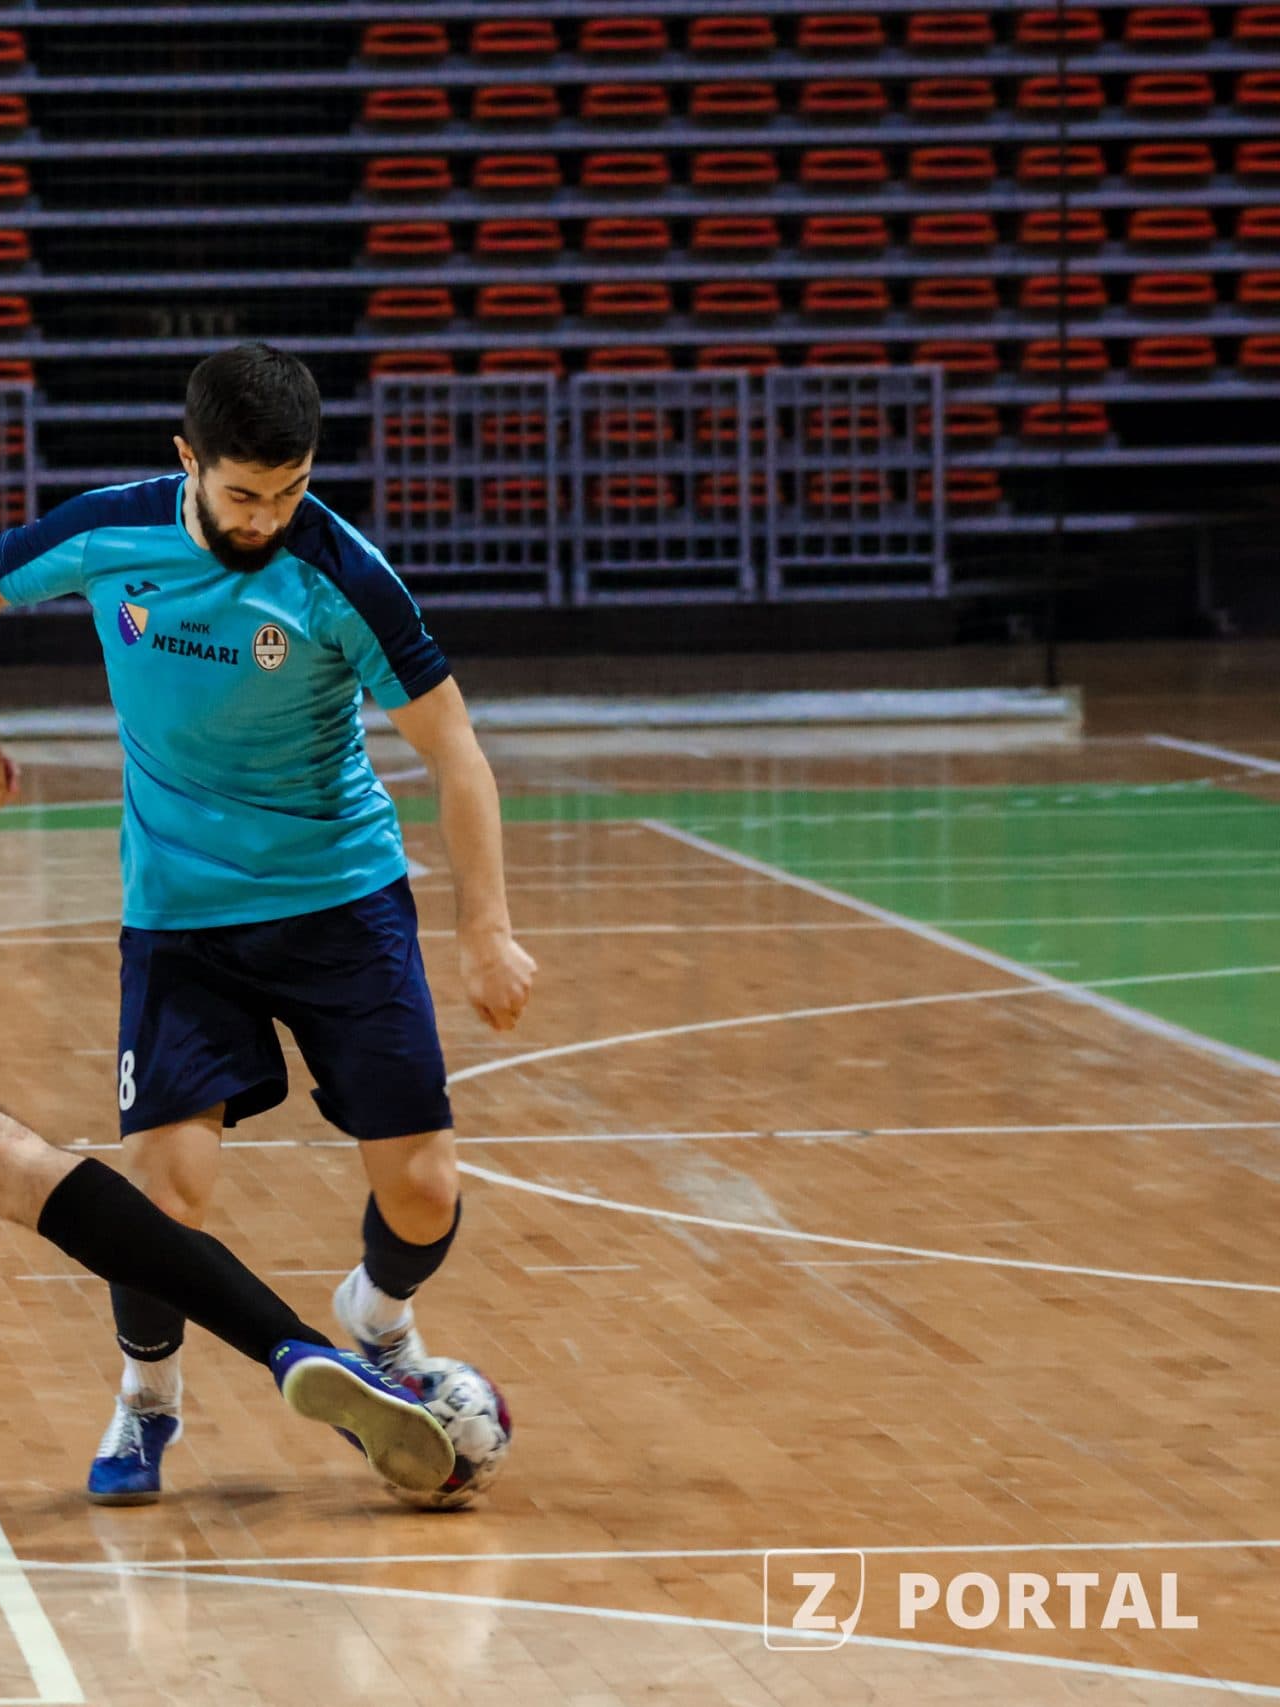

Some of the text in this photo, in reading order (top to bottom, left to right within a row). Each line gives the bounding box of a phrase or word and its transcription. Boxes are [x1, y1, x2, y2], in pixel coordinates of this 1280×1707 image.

[180, 621, 211, 635] MNK
[151, 633, 239, 665] NEIMARI
[119, 1049, 137, 1112] 8
